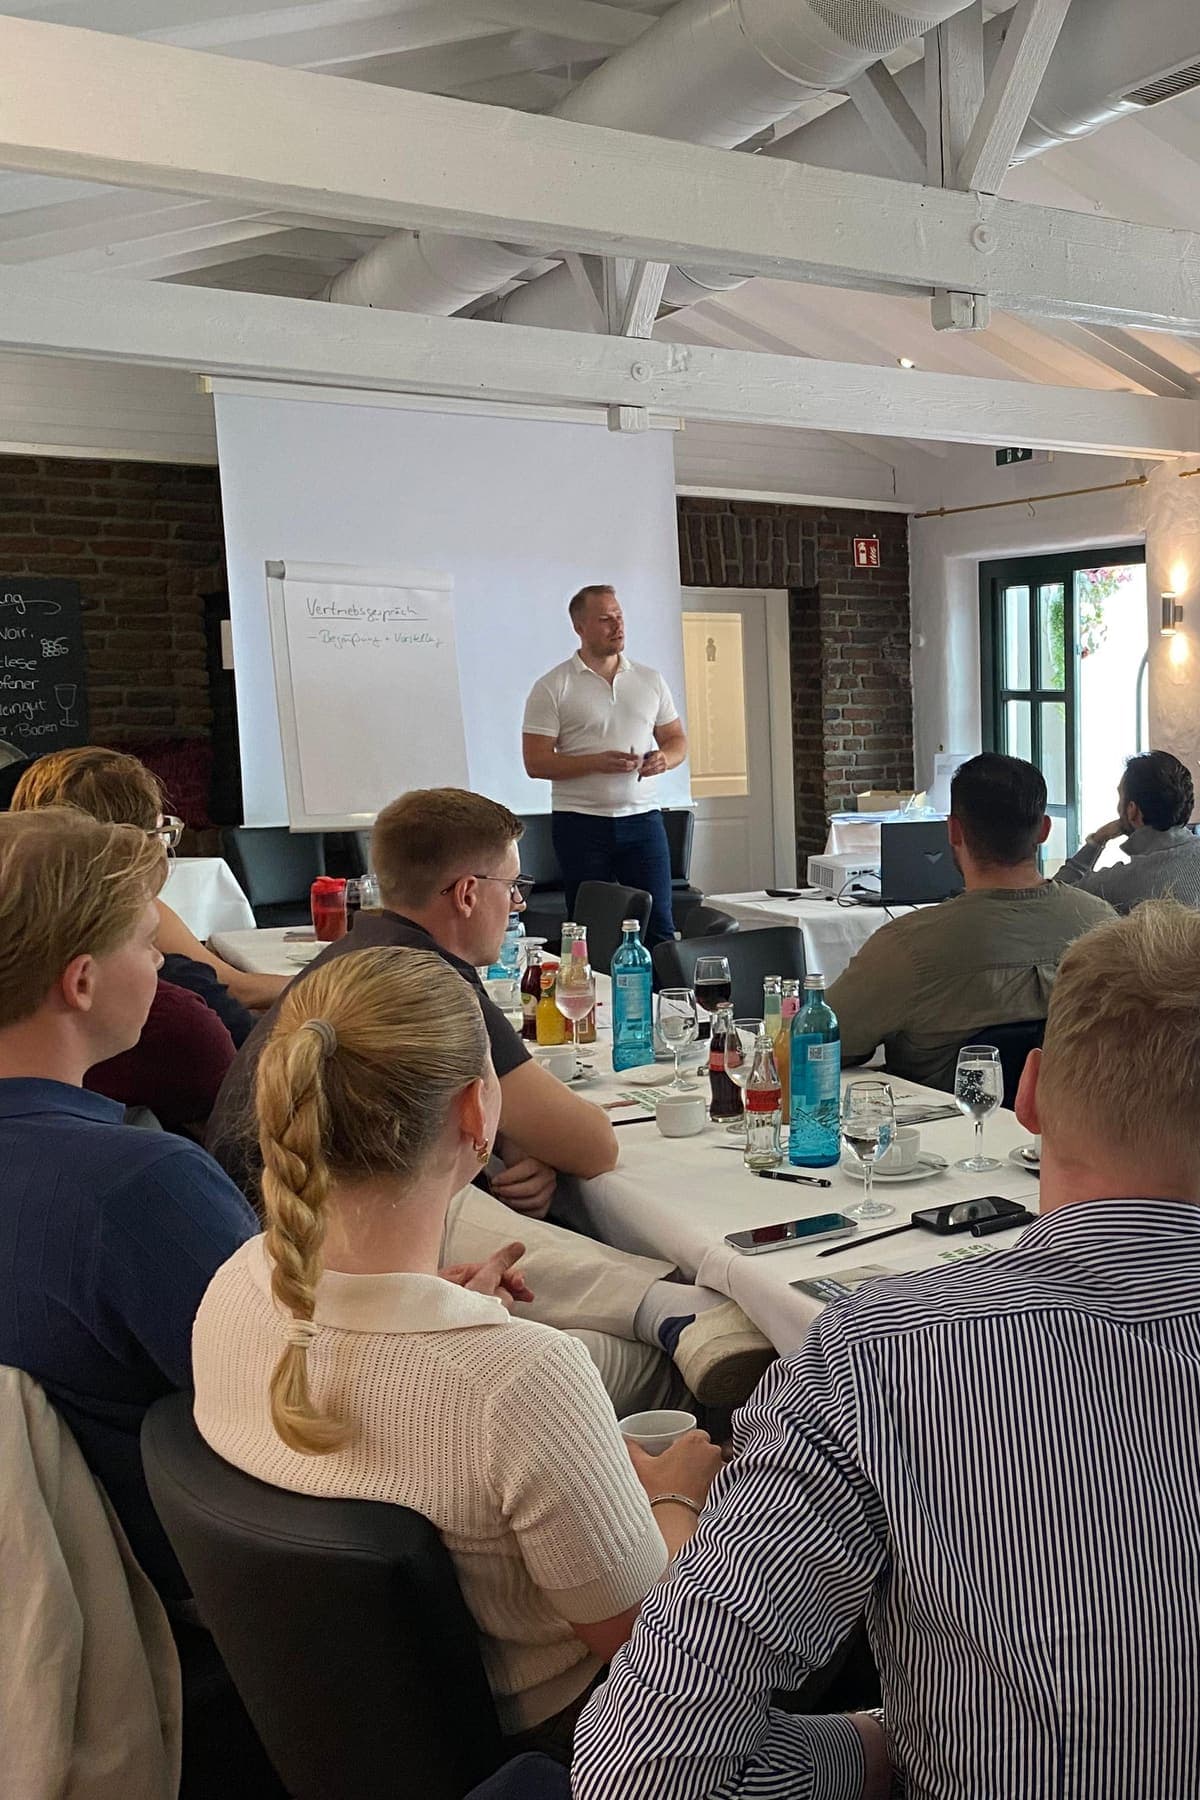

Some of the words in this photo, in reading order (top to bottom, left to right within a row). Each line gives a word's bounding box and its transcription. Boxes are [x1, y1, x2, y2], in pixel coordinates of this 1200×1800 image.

[0, 593, 26, 614] ng
[0, 655, 37, 671] lese
[0, 699, 47, 720] eingut
